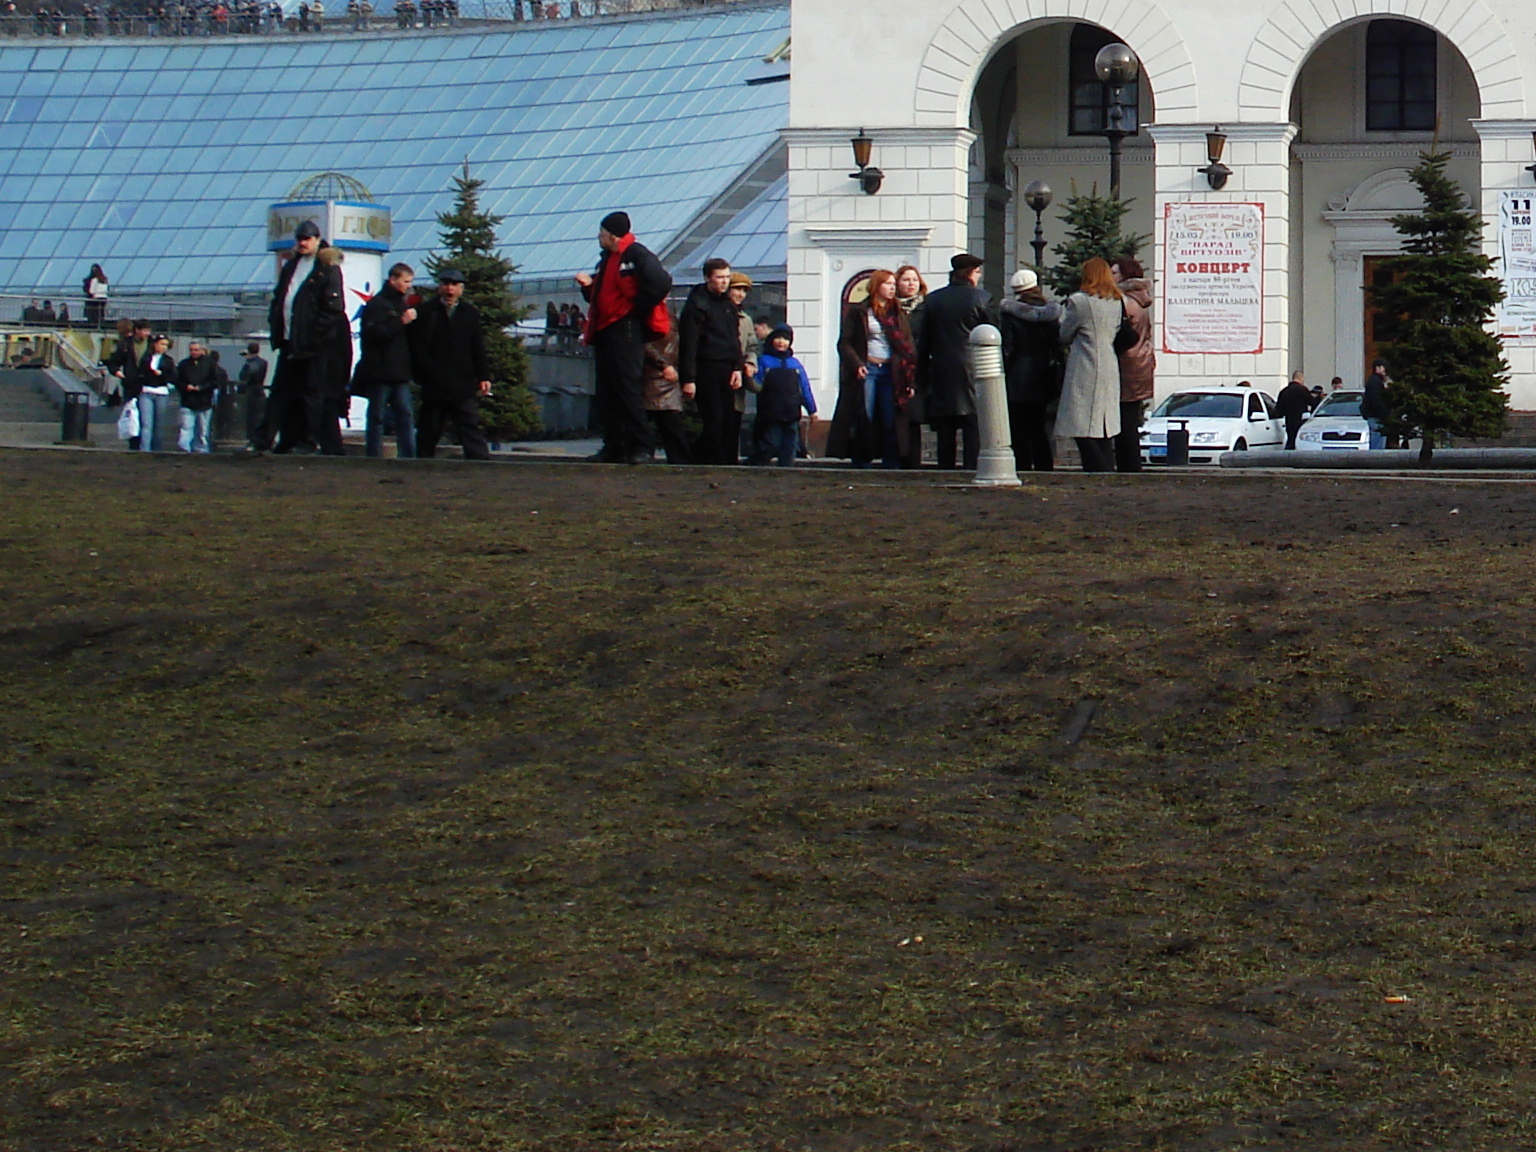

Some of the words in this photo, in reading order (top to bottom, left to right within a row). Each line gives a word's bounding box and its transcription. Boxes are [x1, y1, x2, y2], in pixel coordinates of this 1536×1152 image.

[1511, 199, 1531, 210] 11
[1511, 215, 1531, 225] 19.00
[1176, 262, 1251, 274] КОНЦЕРТ
